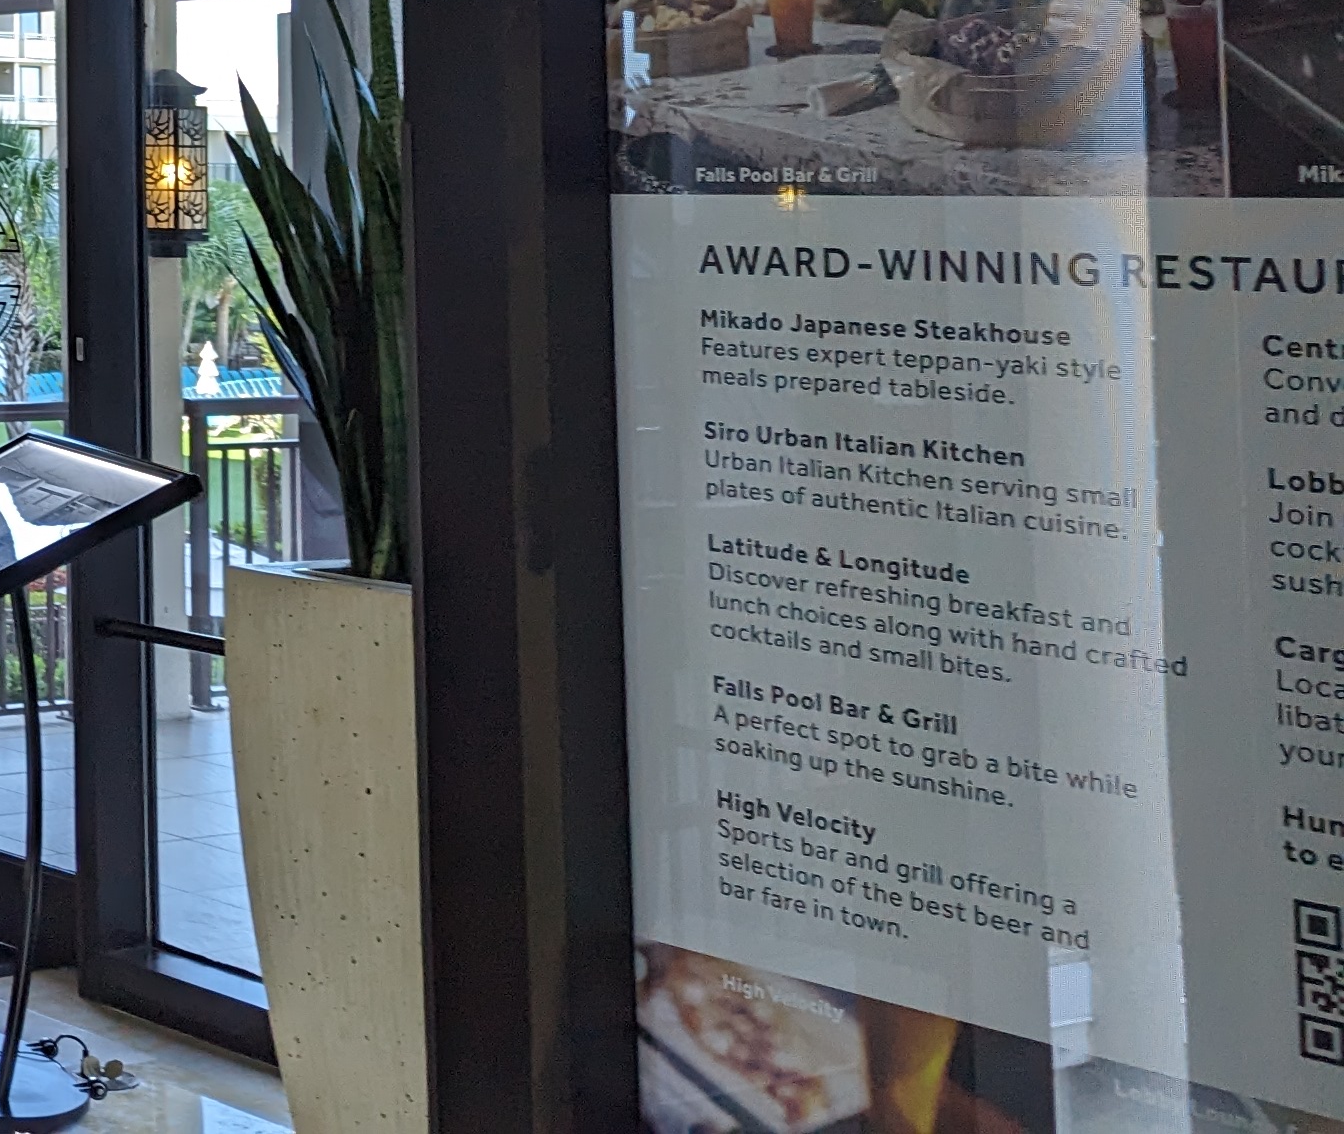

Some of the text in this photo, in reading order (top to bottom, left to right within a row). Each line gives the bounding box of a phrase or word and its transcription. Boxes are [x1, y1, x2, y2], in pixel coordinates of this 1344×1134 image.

[695, 167, 879, 183] Falls Pool Bar & Grill
[699, 244, 1101, 287] AWARD-WINNING
[701, 309, 1071, 346] Mikado Japanese Steakhouse
[701, 337, 1121, 384] Features expert teppan-yaki style
[702, 368, 1015, 404] meals prepared tableside.
[1264, 367, 1344, 393] Conv
[1265, 404, 1320, 426] and
[704, 421, 1025, 467] Siro Urban Italian Kitchen
[705, 449, 772, 473] Urban
[779, 456, 851, 482] Italian
[859, 464, 953, 491] Kitchen
[961, 478, 1058, 506] serving
[706, 479, 1128, 540] plates of authentic Italian cuisine.
[1269, 502, 1333, 527] Join
[708, 534, 970, 585] Latitude & Longitude
[709, 562, 1132, 636] Discover refreshing breakfast and
[709, 591, 1188, 677] lunch choices along with hand crafted
[710, 622, 1012, 682] cocktails and small bites.
[713, 675, 958, 735] Falls Pool Bar & Grill
[713, 704, 1138, 799] A perfect spot to grab a bite while
[714, 737, 1014, 808] soaking up the sunshine.
[717, 789, 877, 845] High Velocity
[717, 818, 1077, 915] Sports bar and grill offering a
[1283, 840, 1317, 866] to
[718, 851, 1090, 950] selection of the best beer and
[719, 876, 909, 939] bar fare in town.
[722, 973, 765, 1000] High
